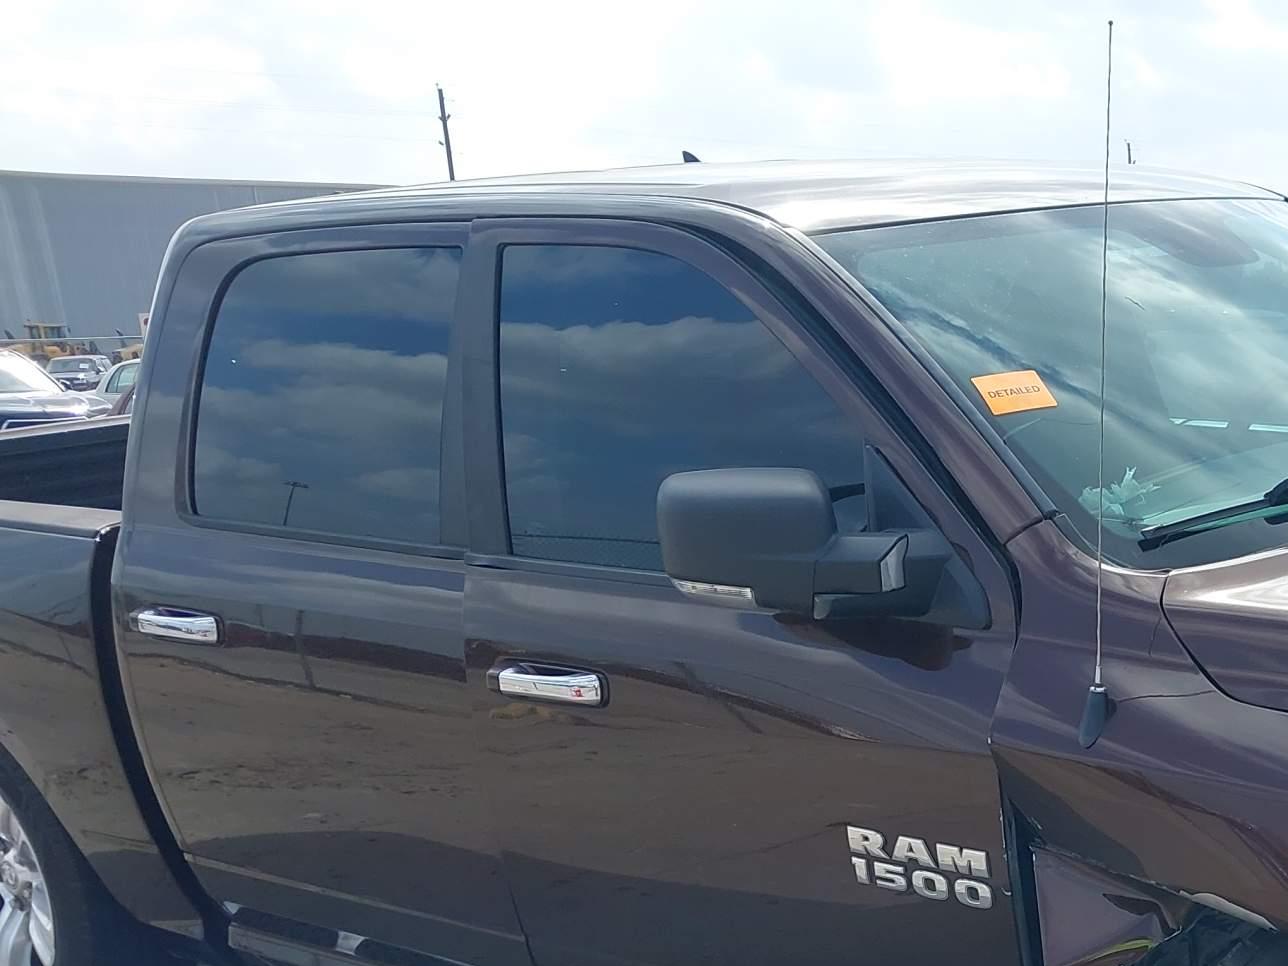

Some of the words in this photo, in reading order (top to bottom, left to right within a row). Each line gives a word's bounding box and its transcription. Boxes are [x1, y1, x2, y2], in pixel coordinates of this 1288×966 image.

[987, 385, 1041, 399] DETAILED
[846, 825, 991, 879] RAM
[851, 856, 993, 910] 1500
